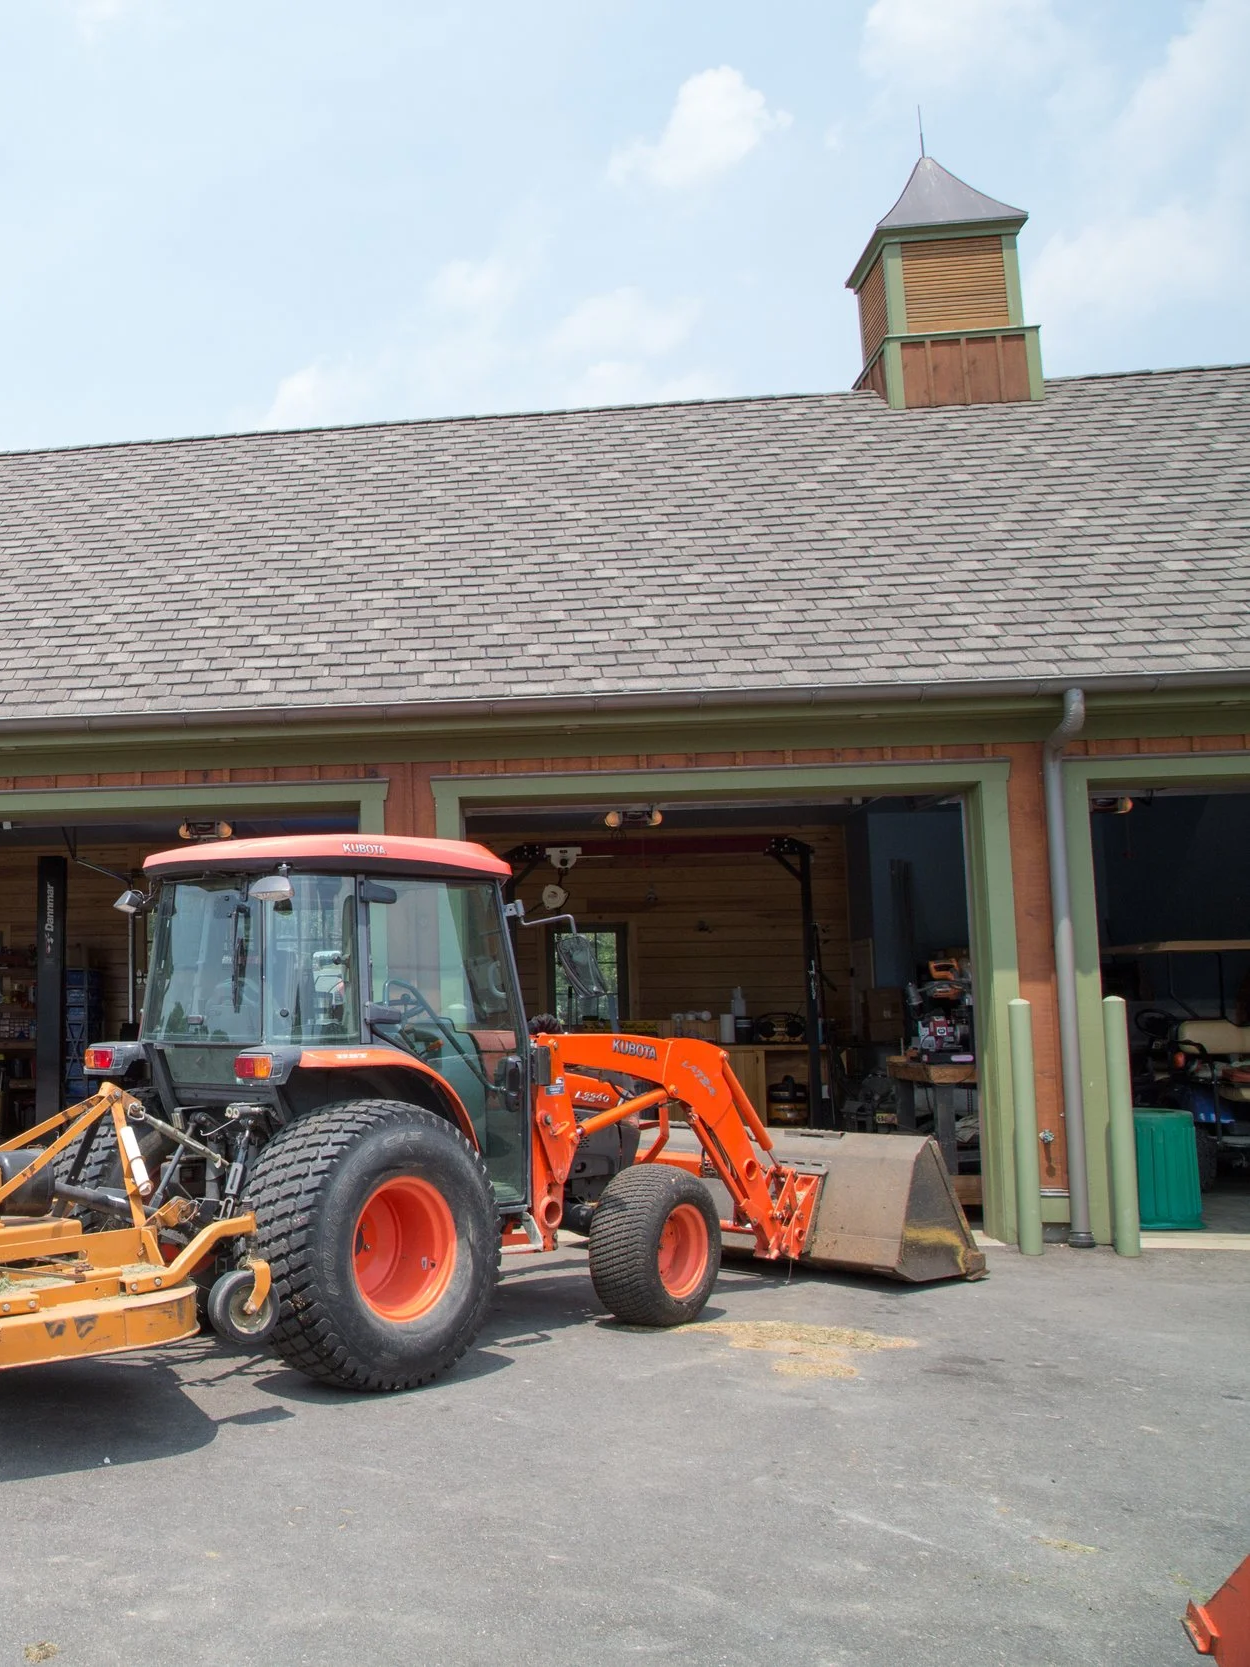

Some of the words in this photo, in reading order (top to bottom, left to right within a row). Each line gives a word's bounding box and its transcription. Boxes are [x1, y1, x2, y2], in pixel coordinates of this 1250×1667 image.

[342, 843, 386, 855] KUBOTA
[44, 881, 54, 932] Dannmar
[612, 1039, 657, 1060] KUBOTA
